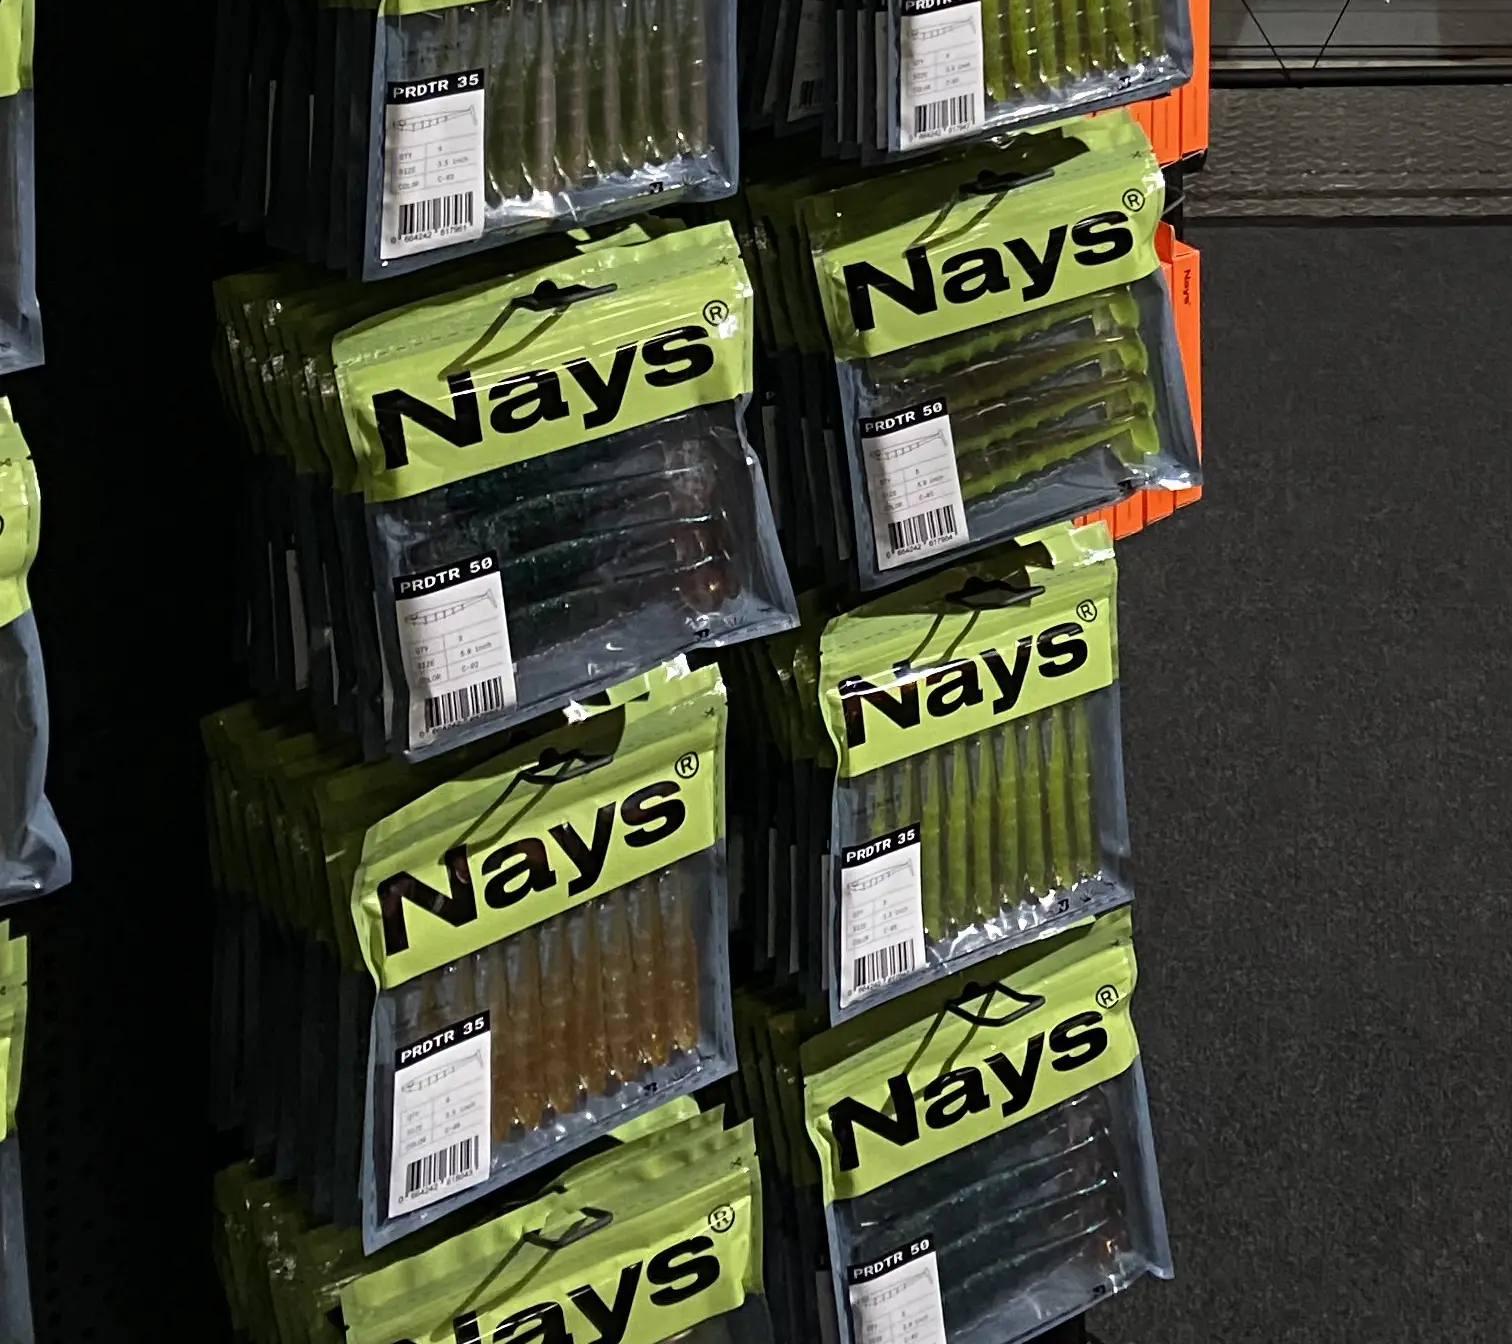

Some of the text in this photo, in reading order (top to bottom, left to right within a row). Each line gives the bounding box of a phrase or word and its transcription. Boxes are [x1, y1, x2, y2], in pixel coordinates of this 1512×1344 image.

[393, 74, 479, 99] PRDTR 35
[864, 401, 943, 433] PRDTR 50
[400, 557, 493, 594] PRDTR 50
[846, 828, 916, 863] PRDTR 35
[400, 1016, 485, 1064] PRDTR 35
[388, 1204, 736, 1344] ays®
[853, 1239, 930, 1279] PRDTR 50
